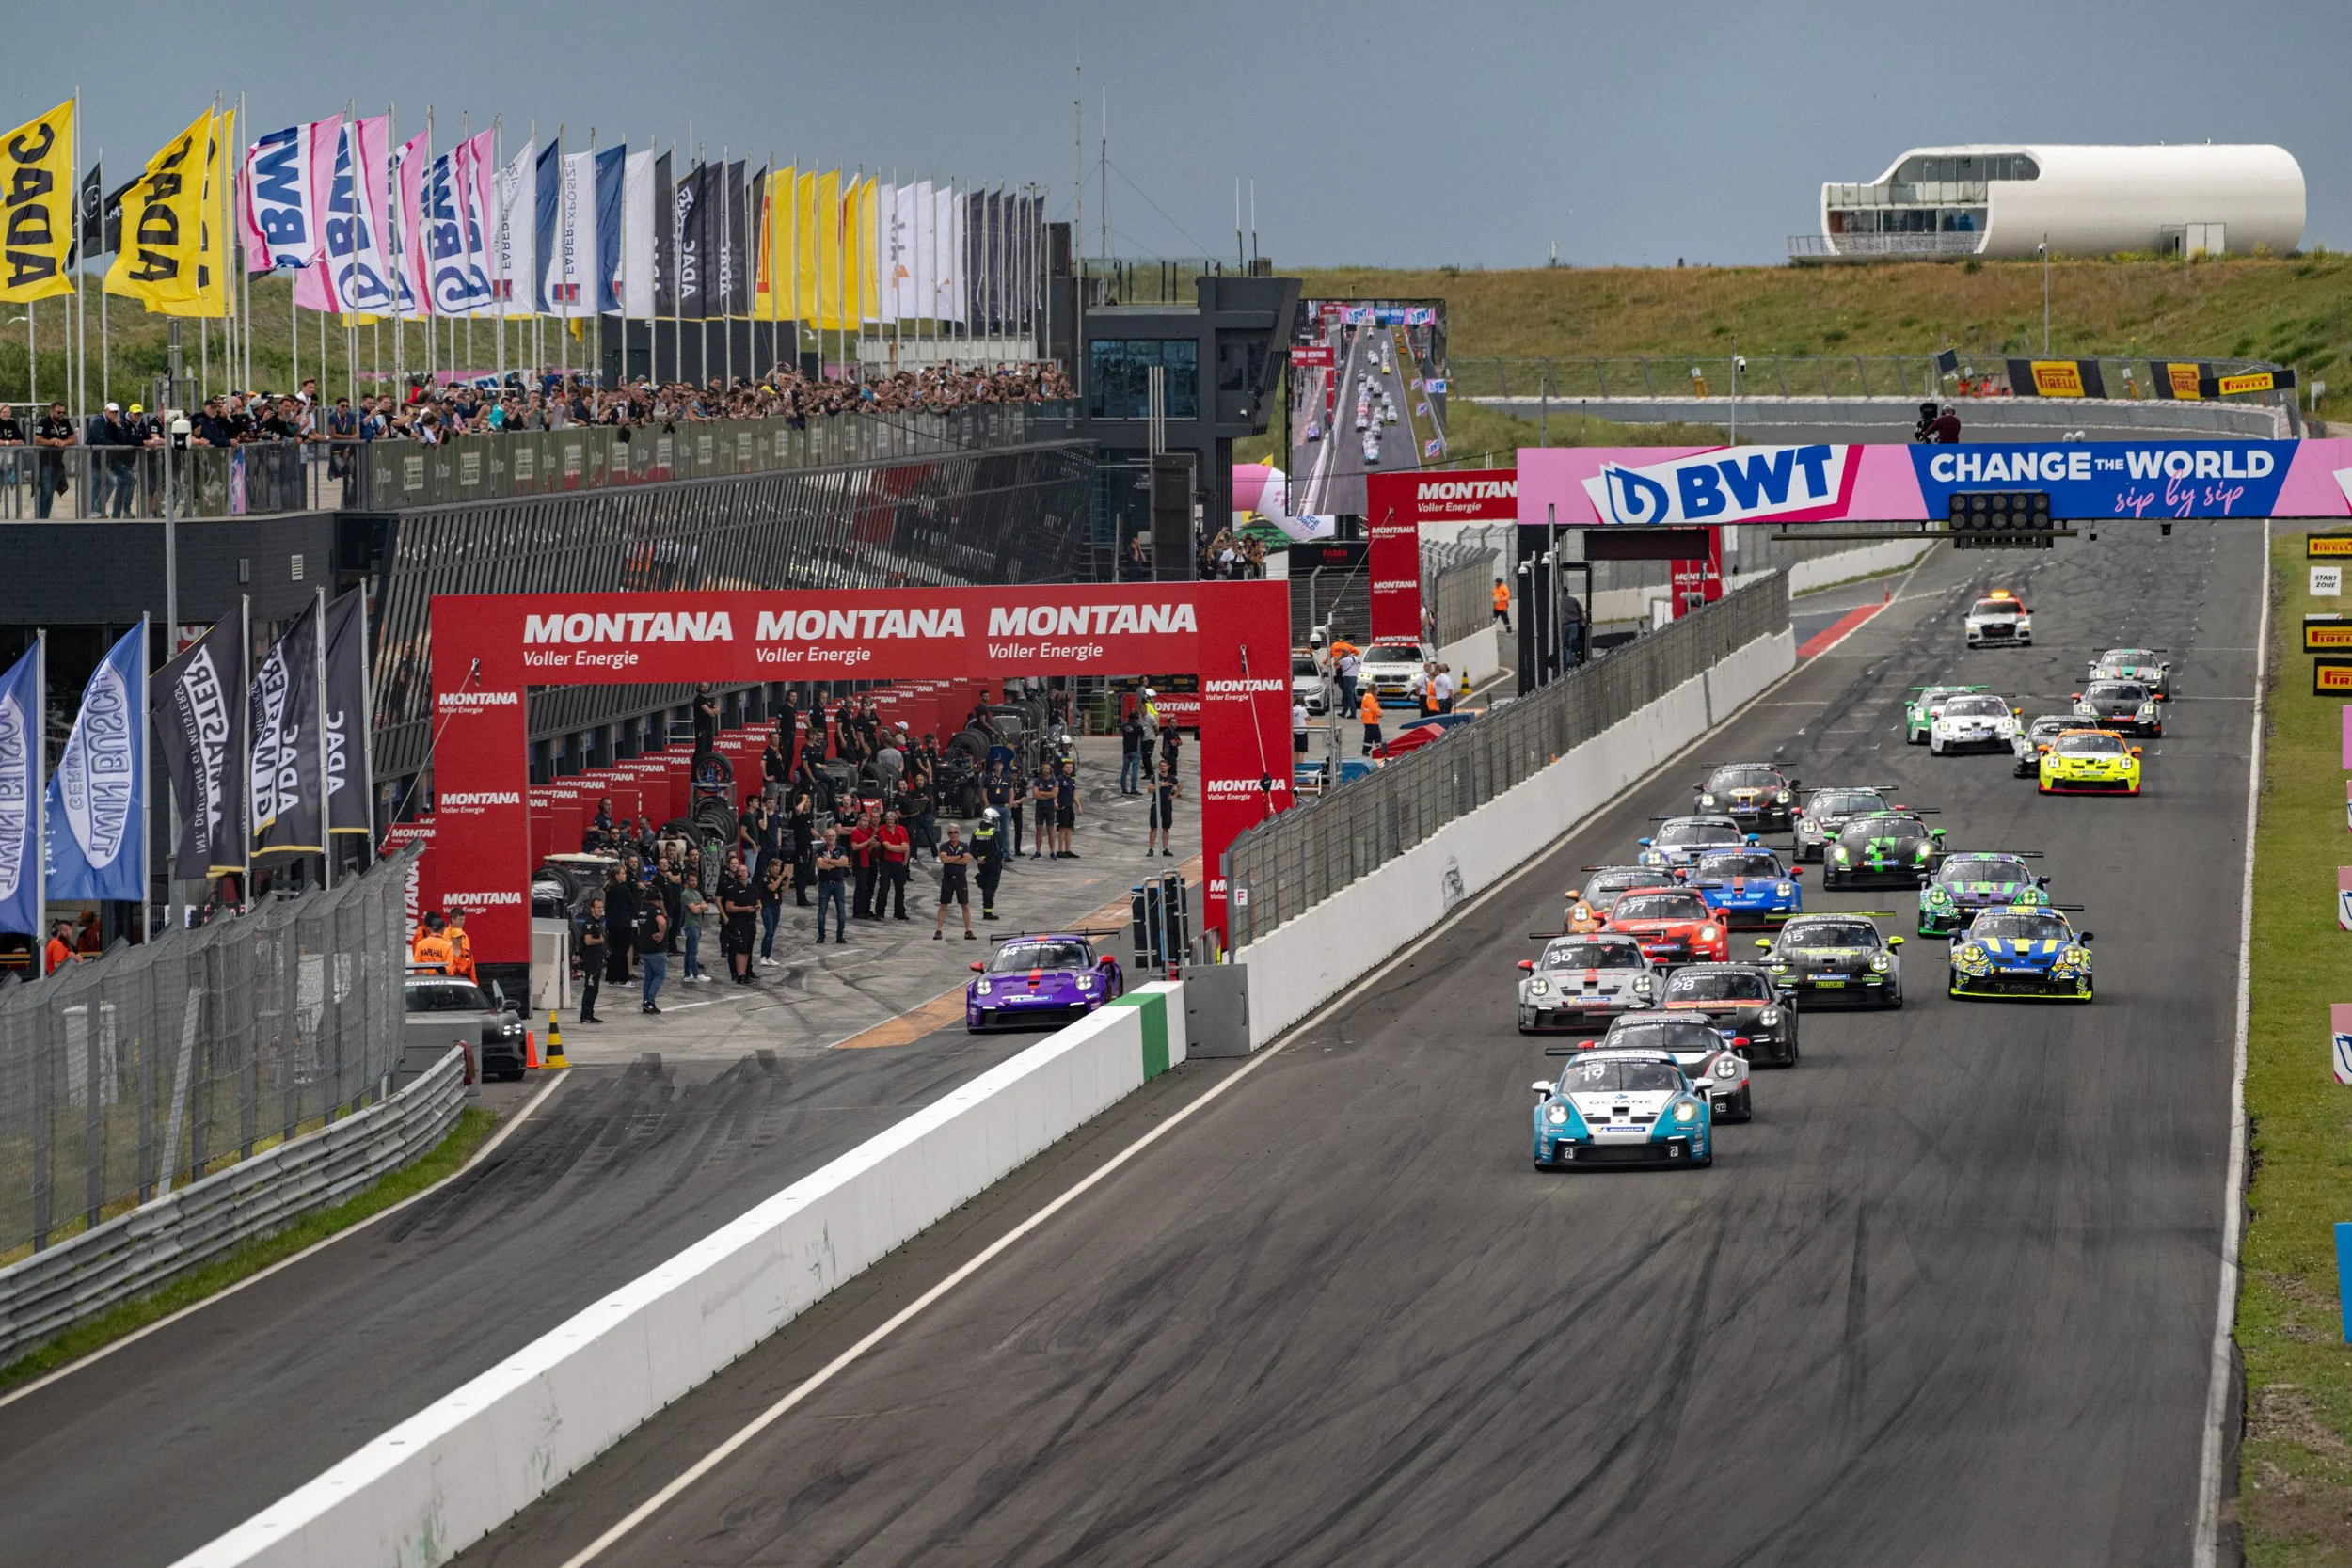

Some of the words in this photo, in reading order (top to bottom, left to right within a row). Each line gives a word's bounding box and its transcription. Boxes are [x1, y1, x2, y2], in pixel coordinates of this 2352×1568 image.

[2036, 370, 2077, 388] PIRELLI
[2224, 376, 2269, 390] PIRELLI
[1930, 452, 2091, 482] CHANGE
[2094, 458, 2124, 471] THE
[2125, 450, 2274, 479] WORLD
[1677, 445, 1832, 519] BWT
[1418, 481, 1518, 499] MONTAN
[2114, 483, 2155, 518] sip
[2165, 469, 2196, 517] by
[2205, 482, 2245, 515] sip
[1446, 503, 1482, 513] Energie
[755, 608, 965, 641] MONTANA
[988, 604, 1197, 636] MONTANA
[523, 611, 734, 643] MONTANA
[756, 648, 804, 663] Voller
[807, 646, 871, 665] Energie
[988, 643, 1036, 658] Voller
[1040, 642, 1103, 661] Energie
[523, 651, 571, 666] Voller
[575, 650, 639, 669] Energie
[1205, 680, 1283, 692] MONTANA
[438, 692, 518, 705] MONTANA
[1153, 702, 1200, 711] ONTANA
[1208, 780, 1285, 792] MONTAA
[441, 792, 520, 805] MONTANA
[461, 806, 485, 815] Energie
[391, 829, 436, 838] MONTAN
[1848, 825, 1867, 833] 33
[1946, 866, 1956, 875] 9
[443, 892, 522, 905] MONTANA
[1237, 892, 1245, 903] F
[1618, 903, 1646, 915] 777
[1979, 921, 1999, 930] 31
[1784, 934, 1804, 943] 15
[421, 947, 443, 958] MARSHAL
[1550, 953, 1572, 964] 30
[1672, 981, 1695, 992] 28
[1610, 1036, 1622, 1045] 2
[1581, 1069, 1605, 1081] 19
